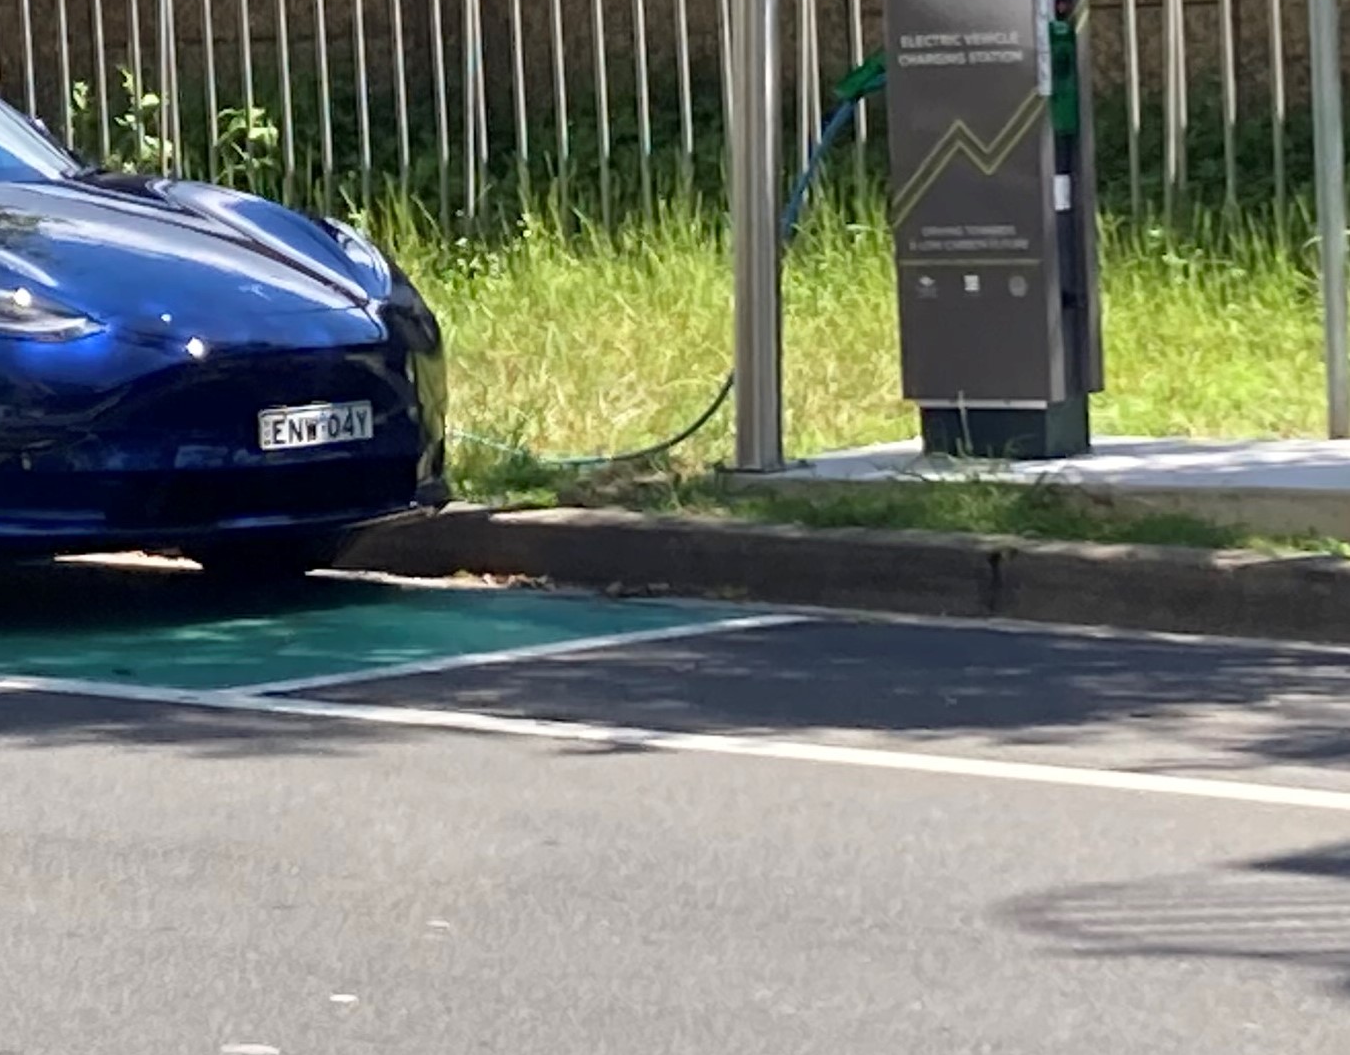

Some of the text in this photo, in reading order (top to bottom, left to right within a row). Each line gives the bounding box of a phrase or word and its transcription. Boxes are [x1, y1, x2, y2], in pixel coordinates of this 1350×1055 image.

[900, 30, 1019, 49] ELECTRIC VEHICLE
[898, 50, 1023, 66] CHARGING STATION
